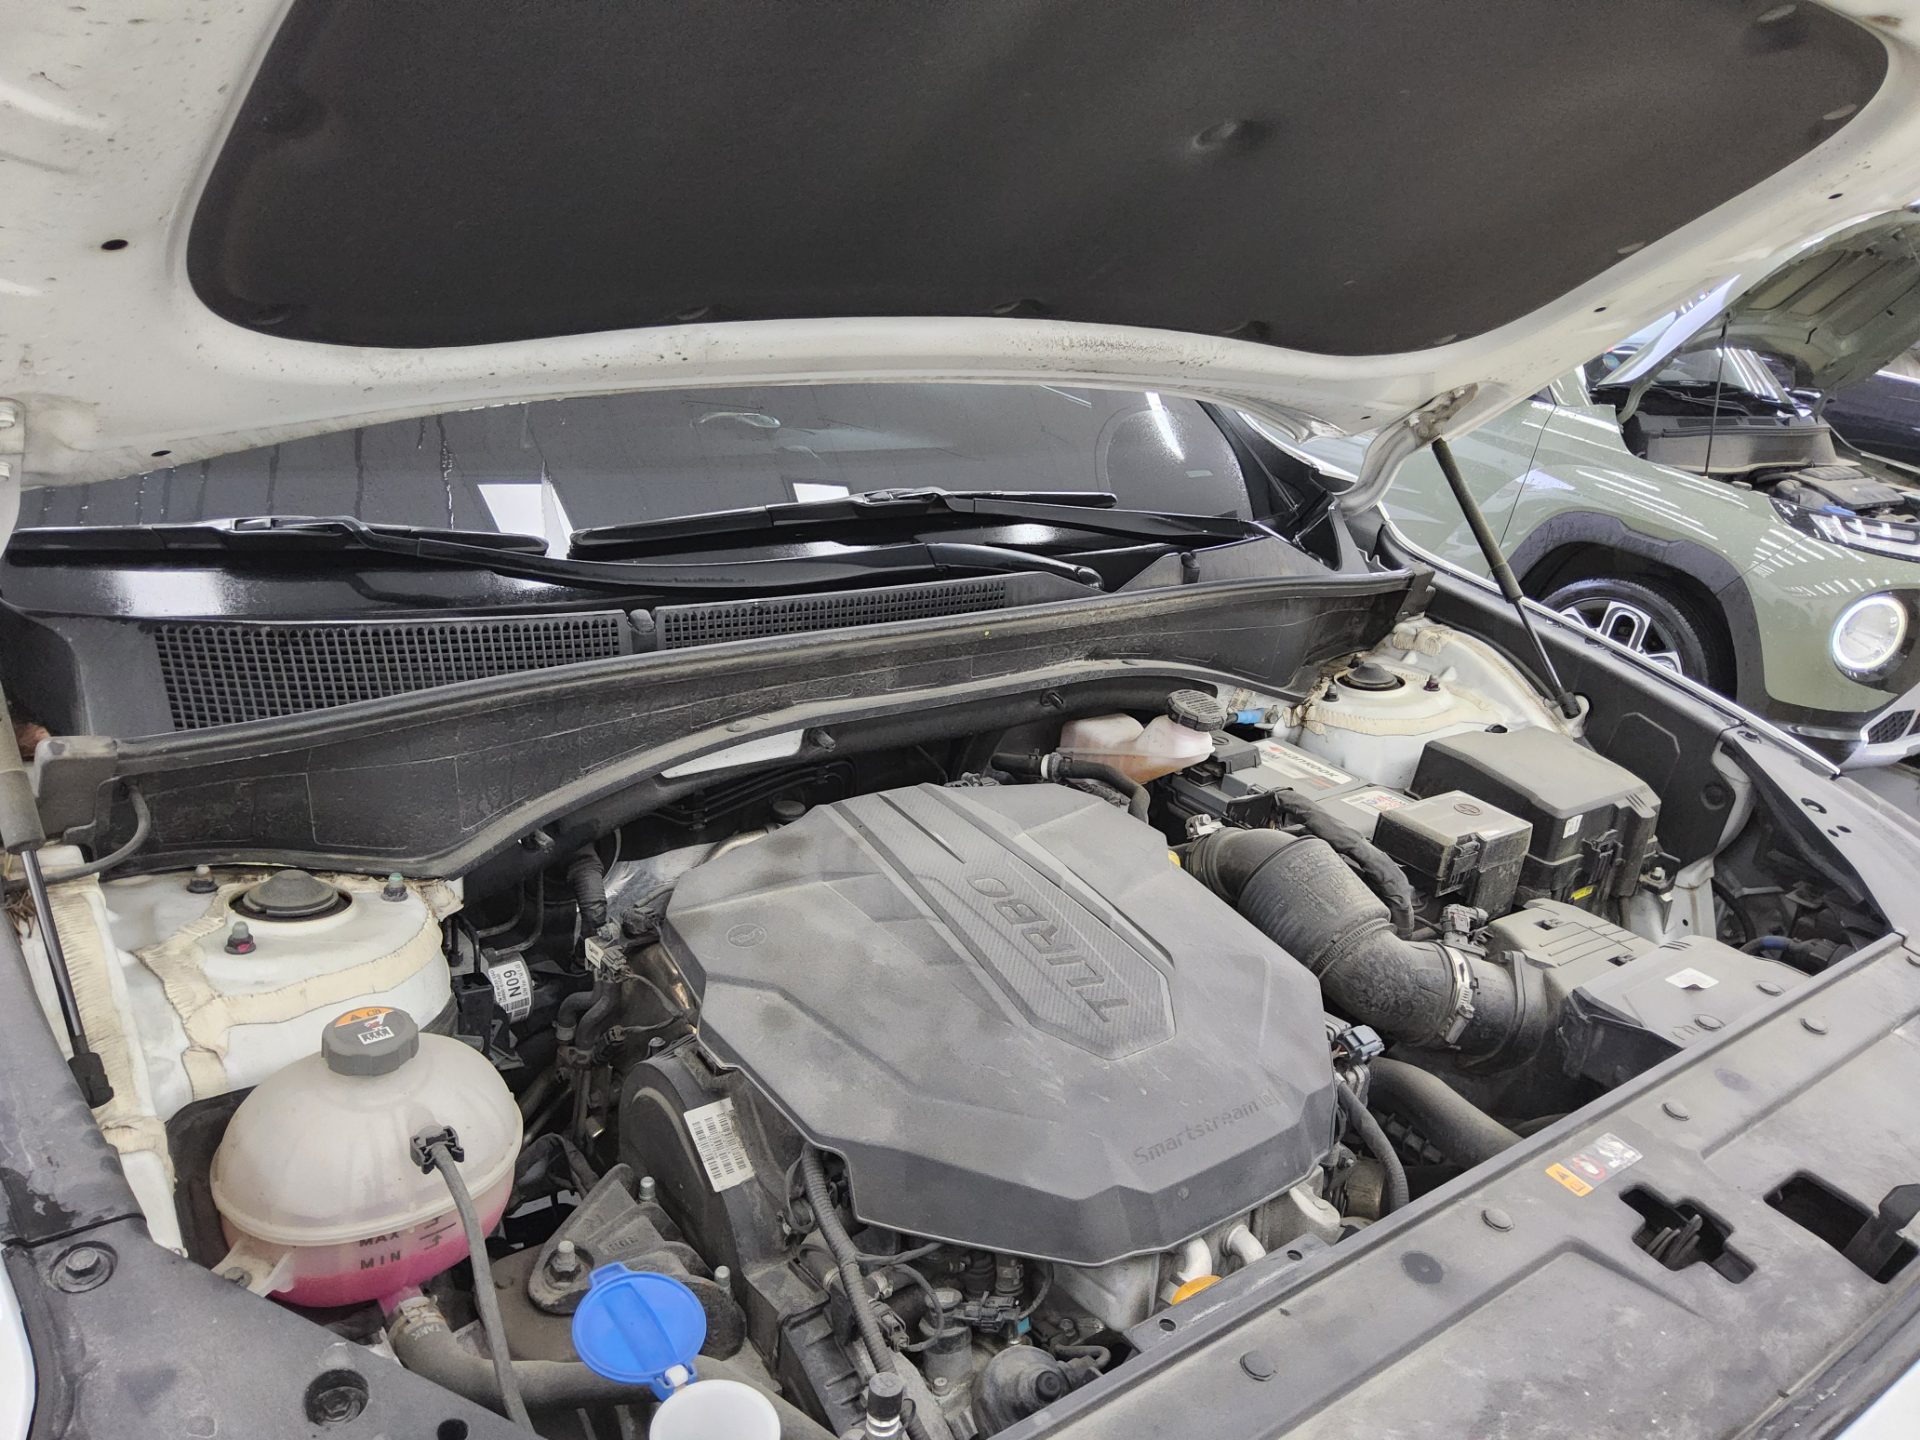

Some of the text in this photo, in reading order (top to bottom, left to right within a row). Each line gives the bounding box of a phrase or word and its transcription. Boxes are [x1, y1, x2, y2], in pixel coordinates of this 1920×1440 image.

[966, 873, 1129, 1023] TURBO
[1133, 1101, 1260, 1166] Smartstream
[359, 1231, 400, 1248] MAX
[360, 1250, 401, 1270] MIN
